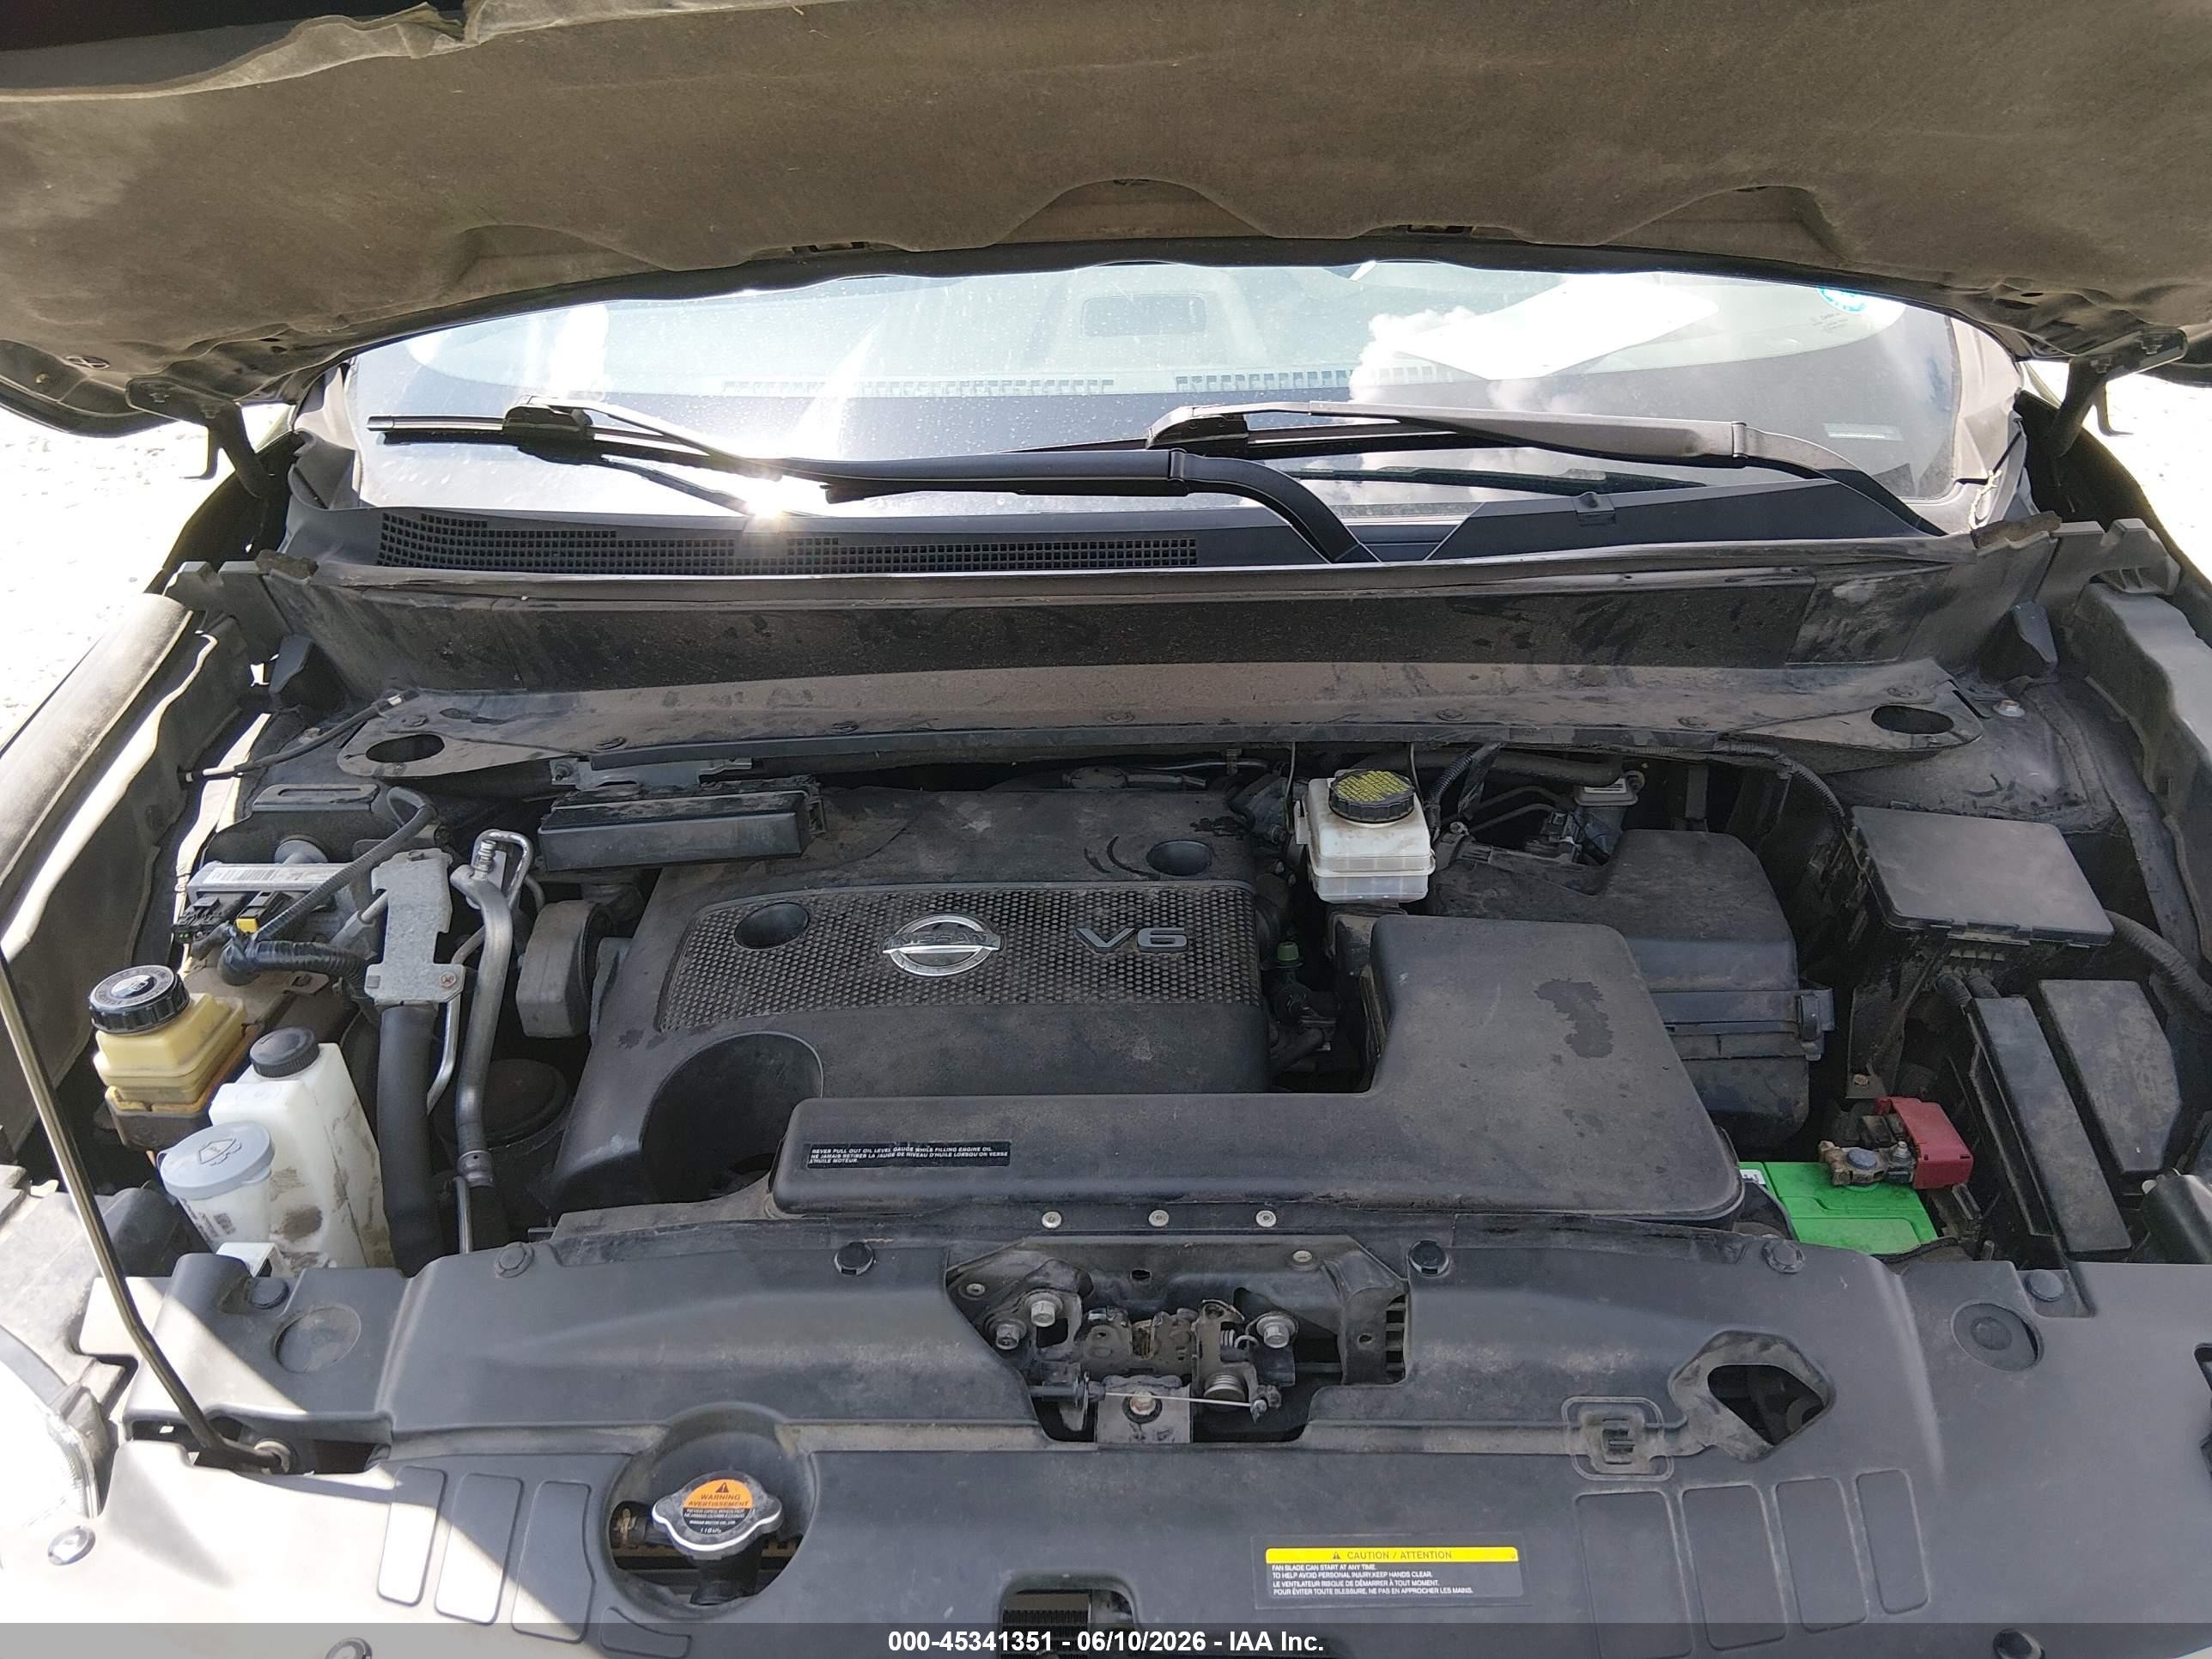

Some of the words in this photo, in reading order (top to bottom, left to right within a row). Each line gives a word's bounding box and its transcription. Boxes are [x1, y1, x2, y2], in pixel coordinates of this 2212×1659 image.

[896, 933, 988, 945] NISSAN
[1076, 927, 1188, 951] V6
[1401, 1551, 1452, 1559] ATTENTION
